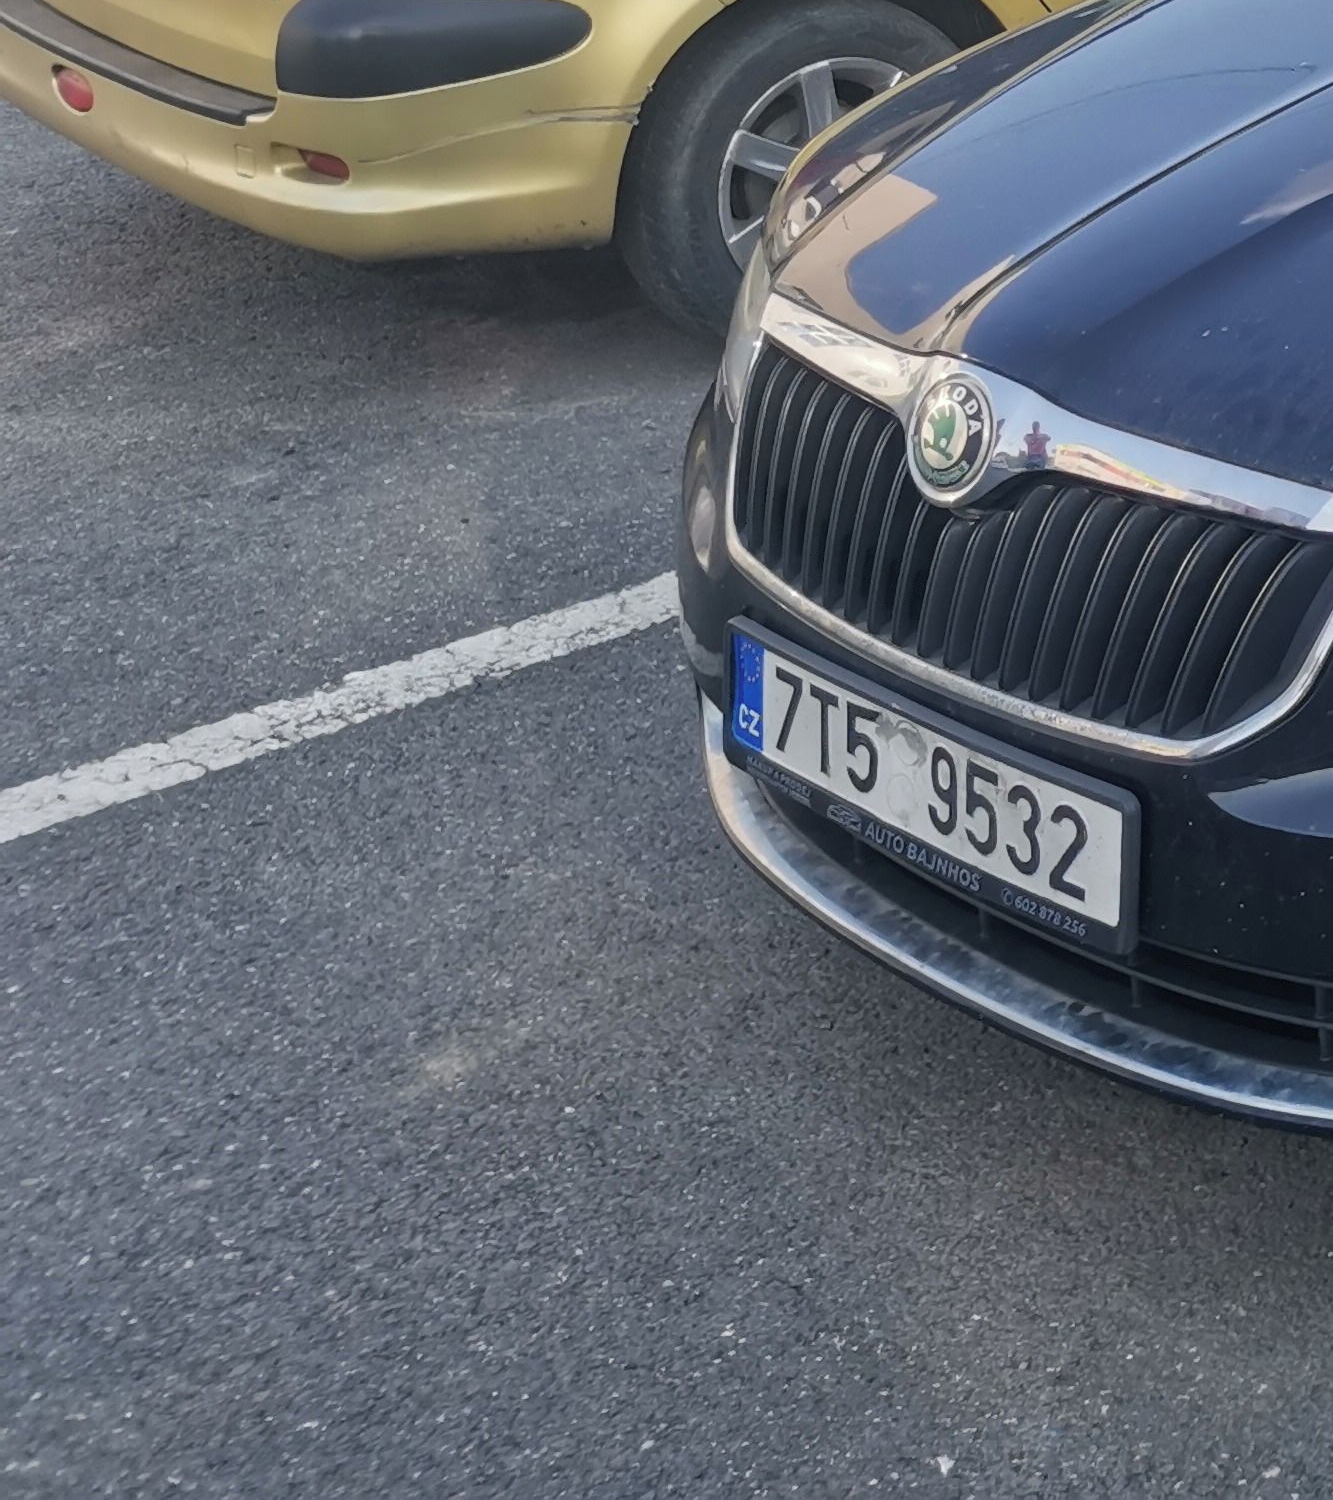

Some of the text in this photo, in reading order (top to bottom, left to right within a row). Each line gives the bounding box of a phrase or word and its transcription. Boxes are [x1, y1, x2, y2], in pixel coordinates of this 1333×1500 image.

[738, 703, 760, 738] CZ
[775, 666, 1089, 902] 7T5 9532
[865, 821, 905, 854] AUTO
[1062, 915, 1086, 937] 256
